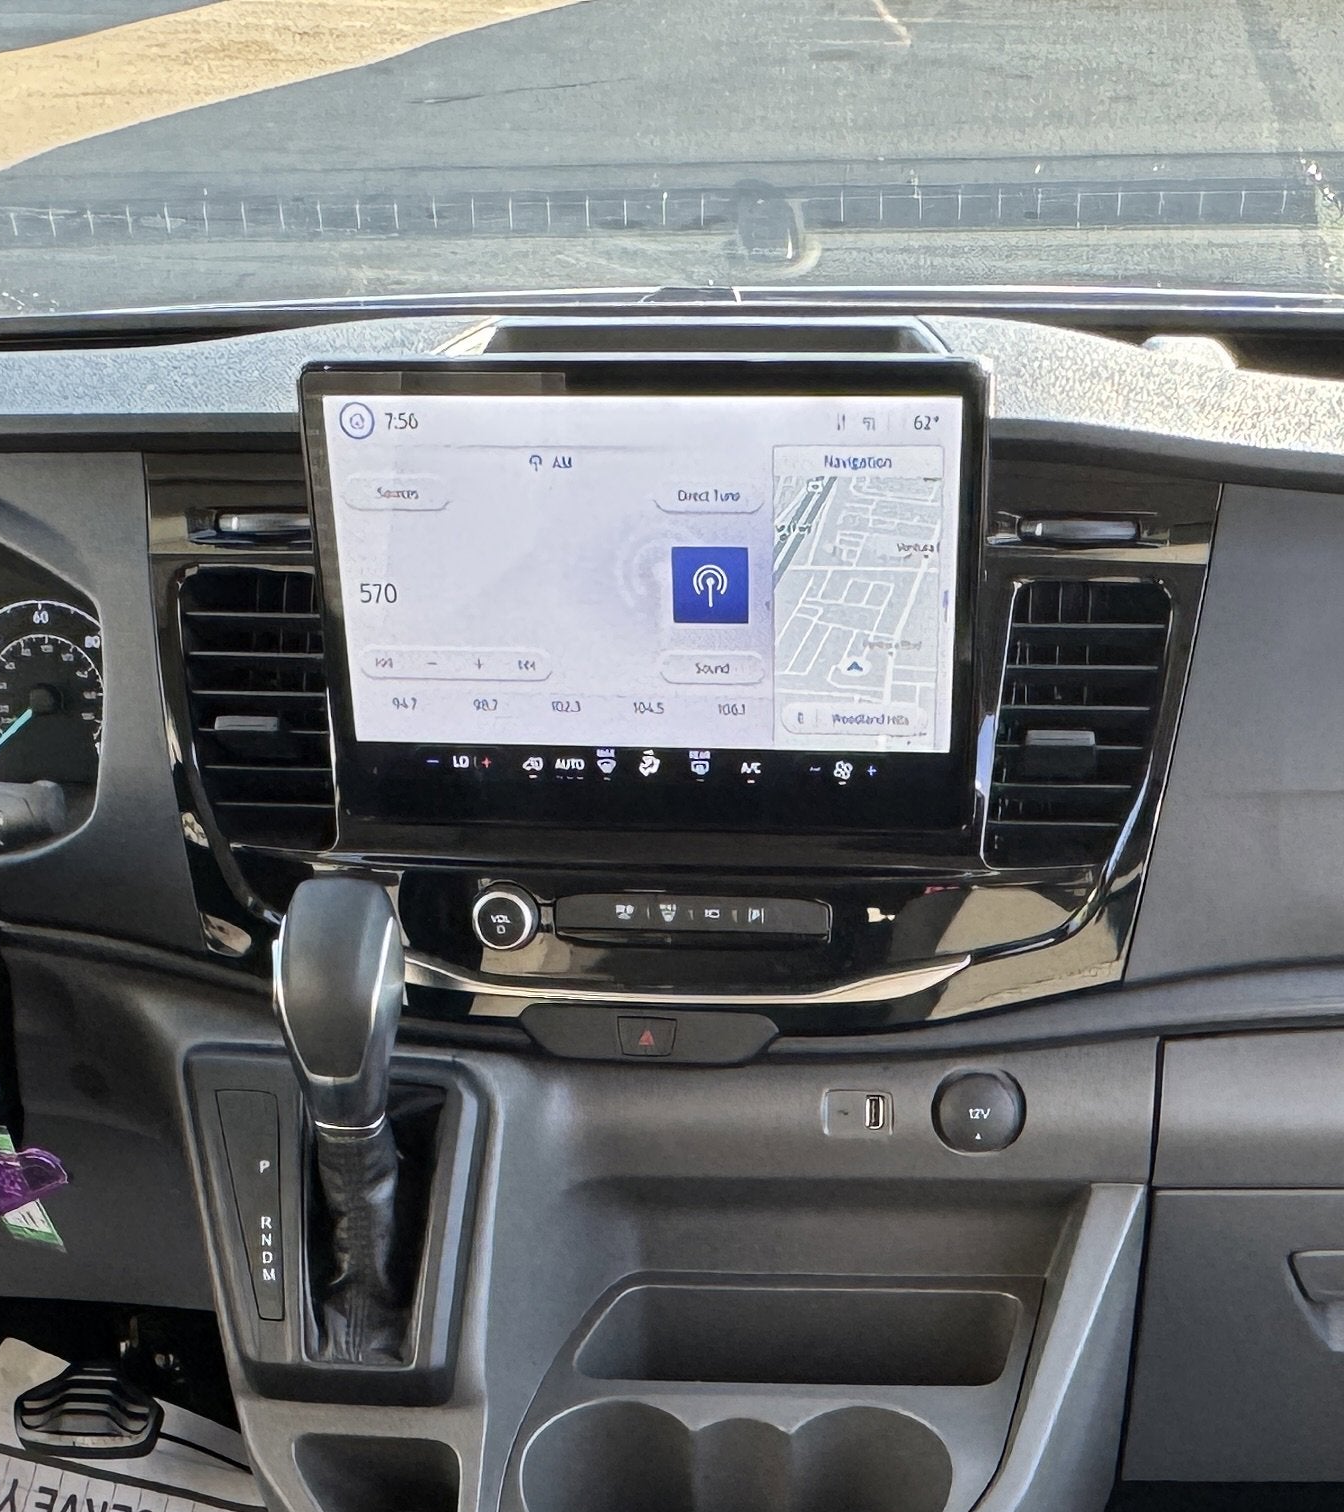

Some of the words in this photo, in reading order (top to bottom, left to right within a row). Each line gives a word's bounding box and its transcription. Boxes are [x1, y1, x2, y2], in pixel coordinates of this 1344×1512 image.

[824, 455, 893, 470] Navigation
[360, 583, 398, 604] 570
[32, 610, 49, 624] 60
[554, 757, 585, 770] AUTO
[259, 1160, 270, 1173] P
[260, 1216, 273, 1229] R
[261, 1234, 272, 1247] N
[262, 1251, 273, 1264] D
[262, 1268, 276, 1281] M
